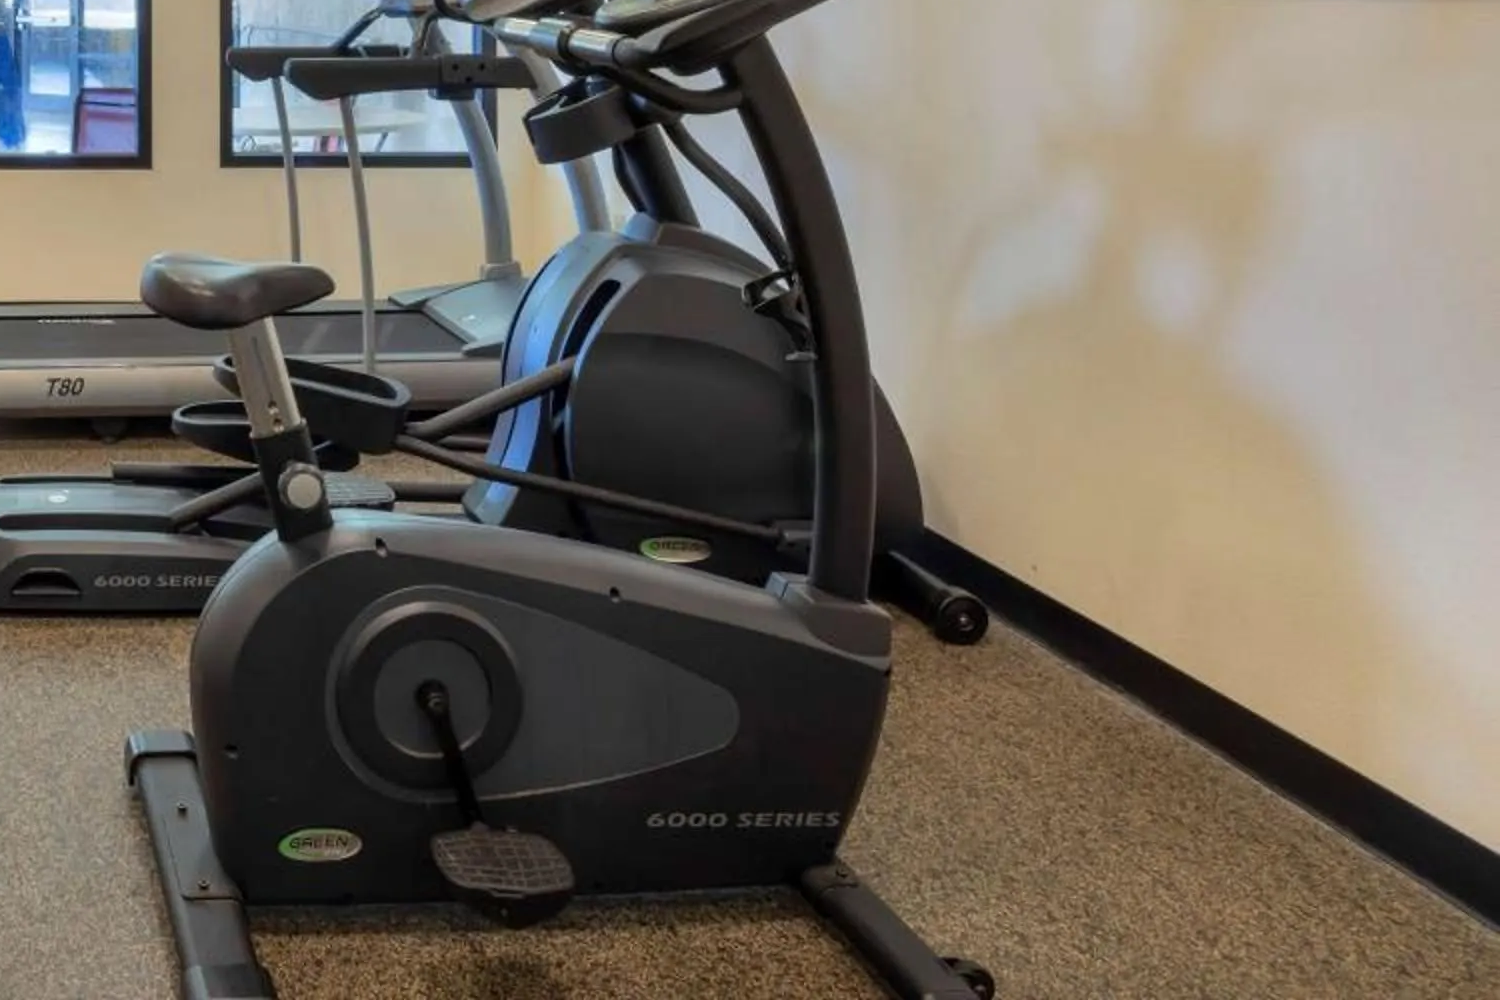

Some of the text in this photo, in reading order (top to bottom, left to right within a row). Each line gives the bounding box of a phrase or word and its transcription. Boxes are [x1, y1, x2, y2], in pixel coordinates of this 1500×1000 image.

[46, 377, 85, 397] T80
[94, 575, 221, 588] 6000 SERIE
[646, 812, 841, 828] 6000 SERIES
[289, 835, 350, 849] GREEN
